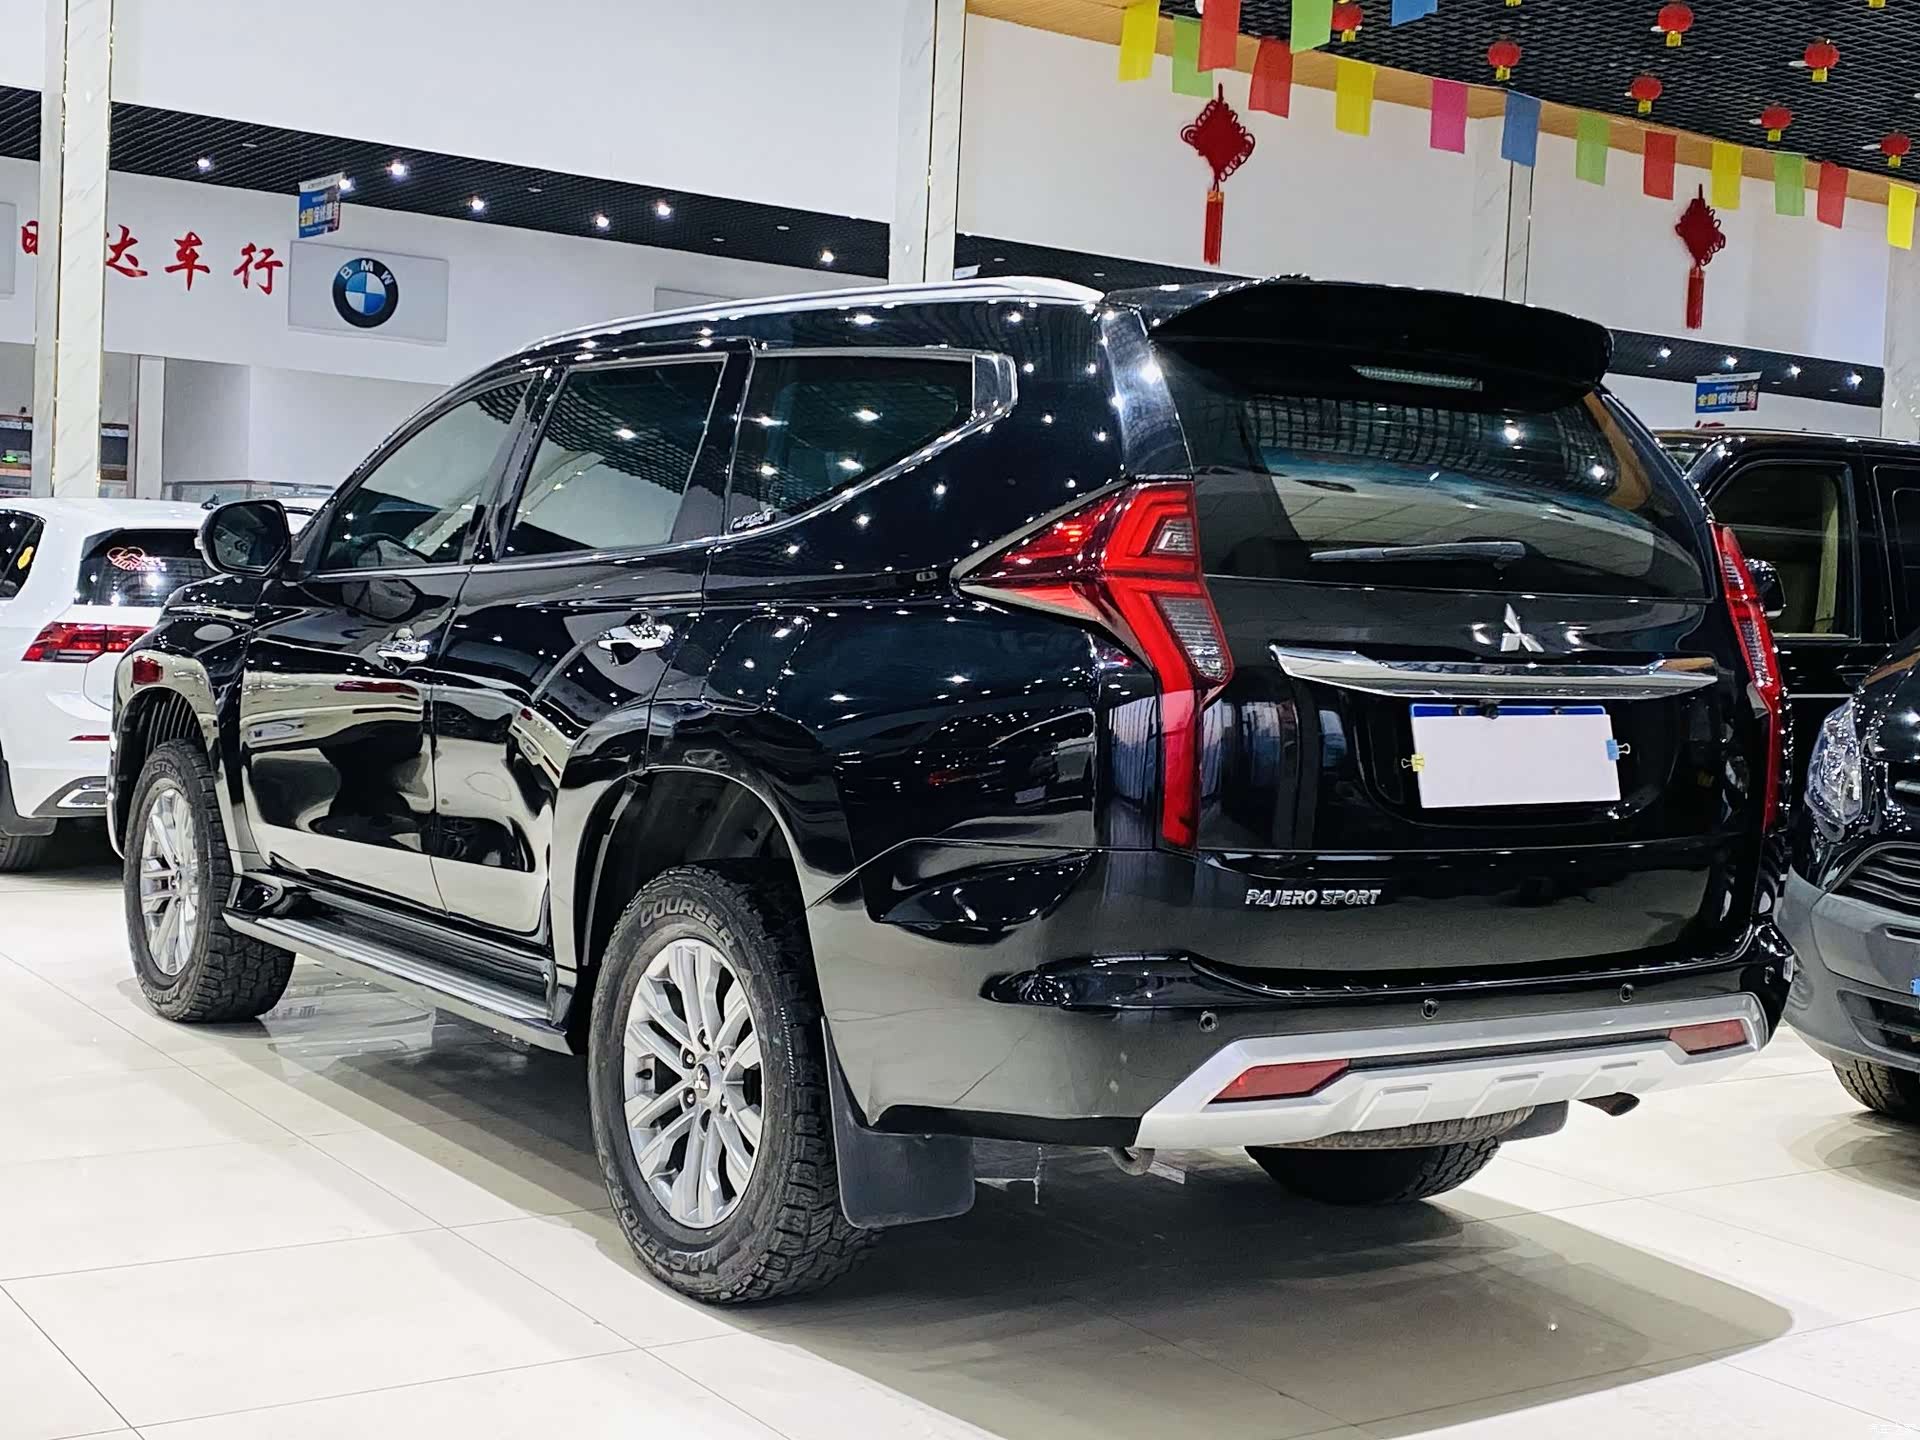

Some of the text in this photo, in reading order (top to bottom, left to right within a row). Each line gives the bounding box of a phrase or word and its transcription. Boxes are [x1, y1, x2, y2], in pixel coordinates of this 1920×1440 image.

[340, 259, 394, 286] BMW
[1245, 889, 1382, 907] PAJERO SPORT
[640, 896, 736, 951] COURSER
